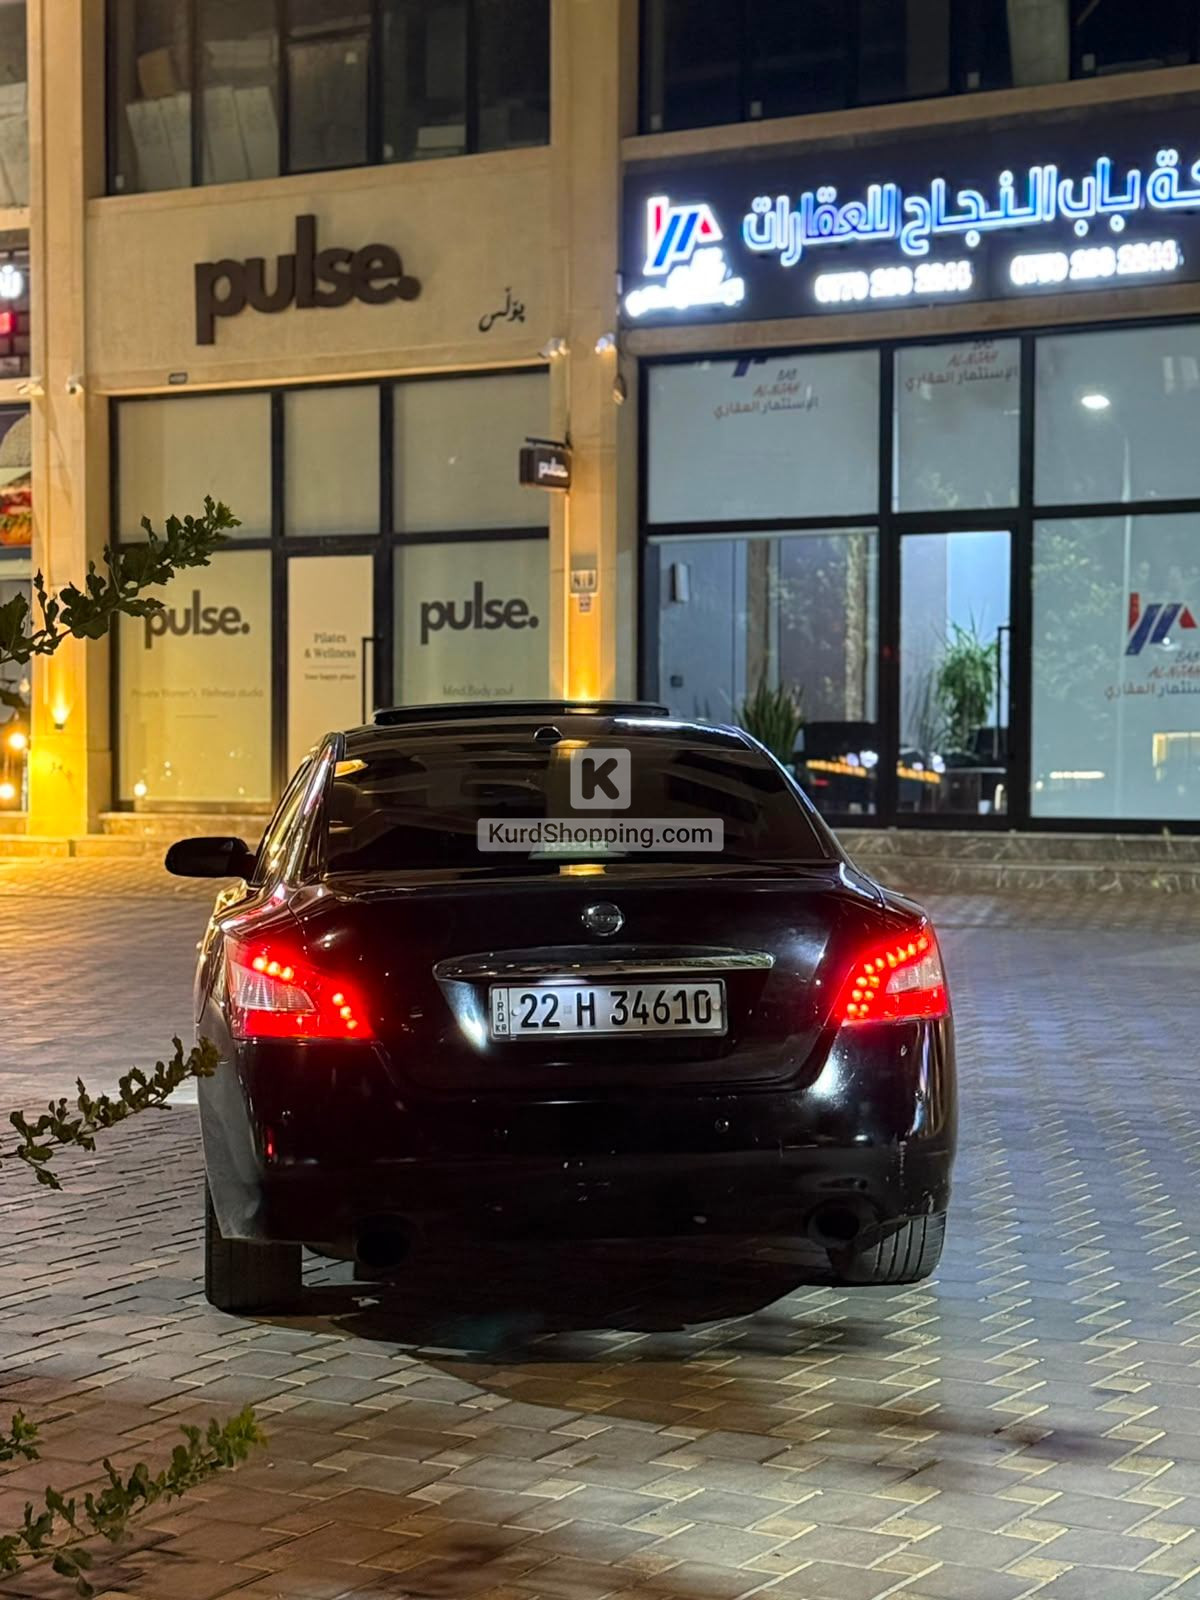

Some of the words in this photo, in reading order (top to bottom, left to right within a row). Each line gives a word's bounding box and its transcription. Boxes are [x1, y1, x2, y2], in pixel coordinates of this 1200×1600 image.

[743, 183, 901, 267] للعقارات
[901, 165, 1058, 255] النجاح
[1058, 157, 1141, 237] باب
[195, 213, 422, 345] pulse.
[144, 589, 250, 650] pulse.
[420, 581, 540, 645] pulse.
[304, 648, 312, 659] &
[313, 647, 356, 659] Wellness
[519, 993, 561, 1029] 22
[575, 991, 596, 1028] H
[610, 989, 713, 1026] 34610
